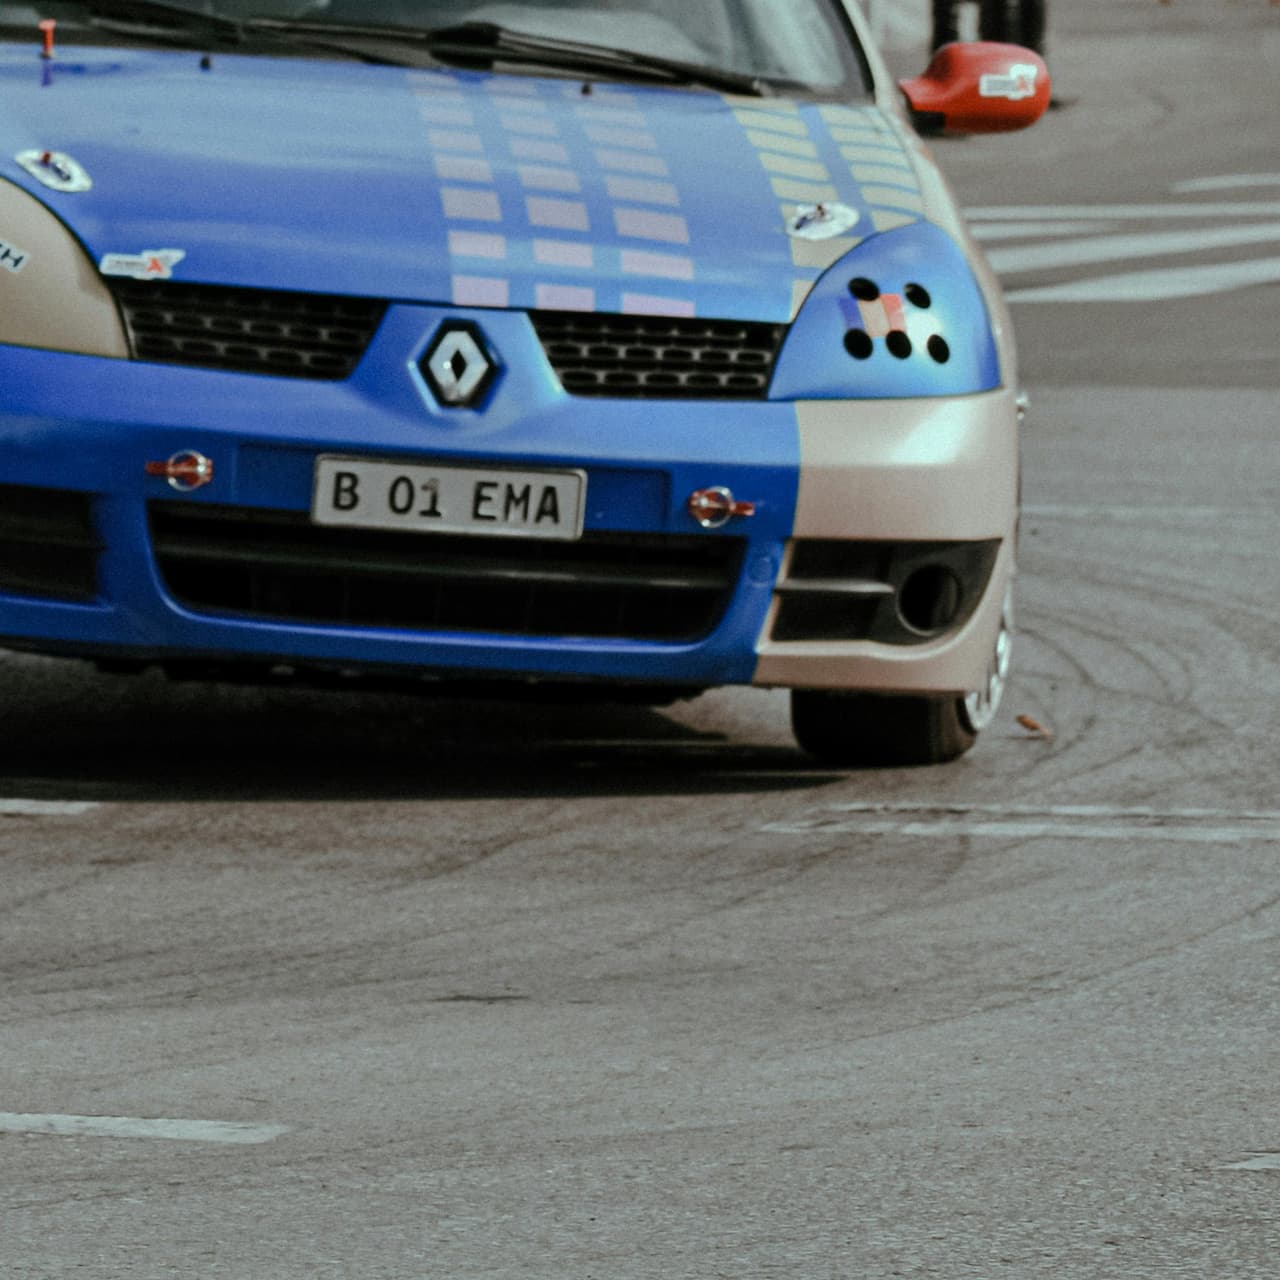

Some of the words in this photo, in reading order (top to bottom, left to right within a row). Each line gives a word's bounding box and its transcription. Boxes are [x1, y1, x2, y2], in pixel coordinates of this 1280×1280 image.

[332, 471, 359, 511] B
[389, 475, 442, 519] 01
[471, 481, 560, 524] EMA
